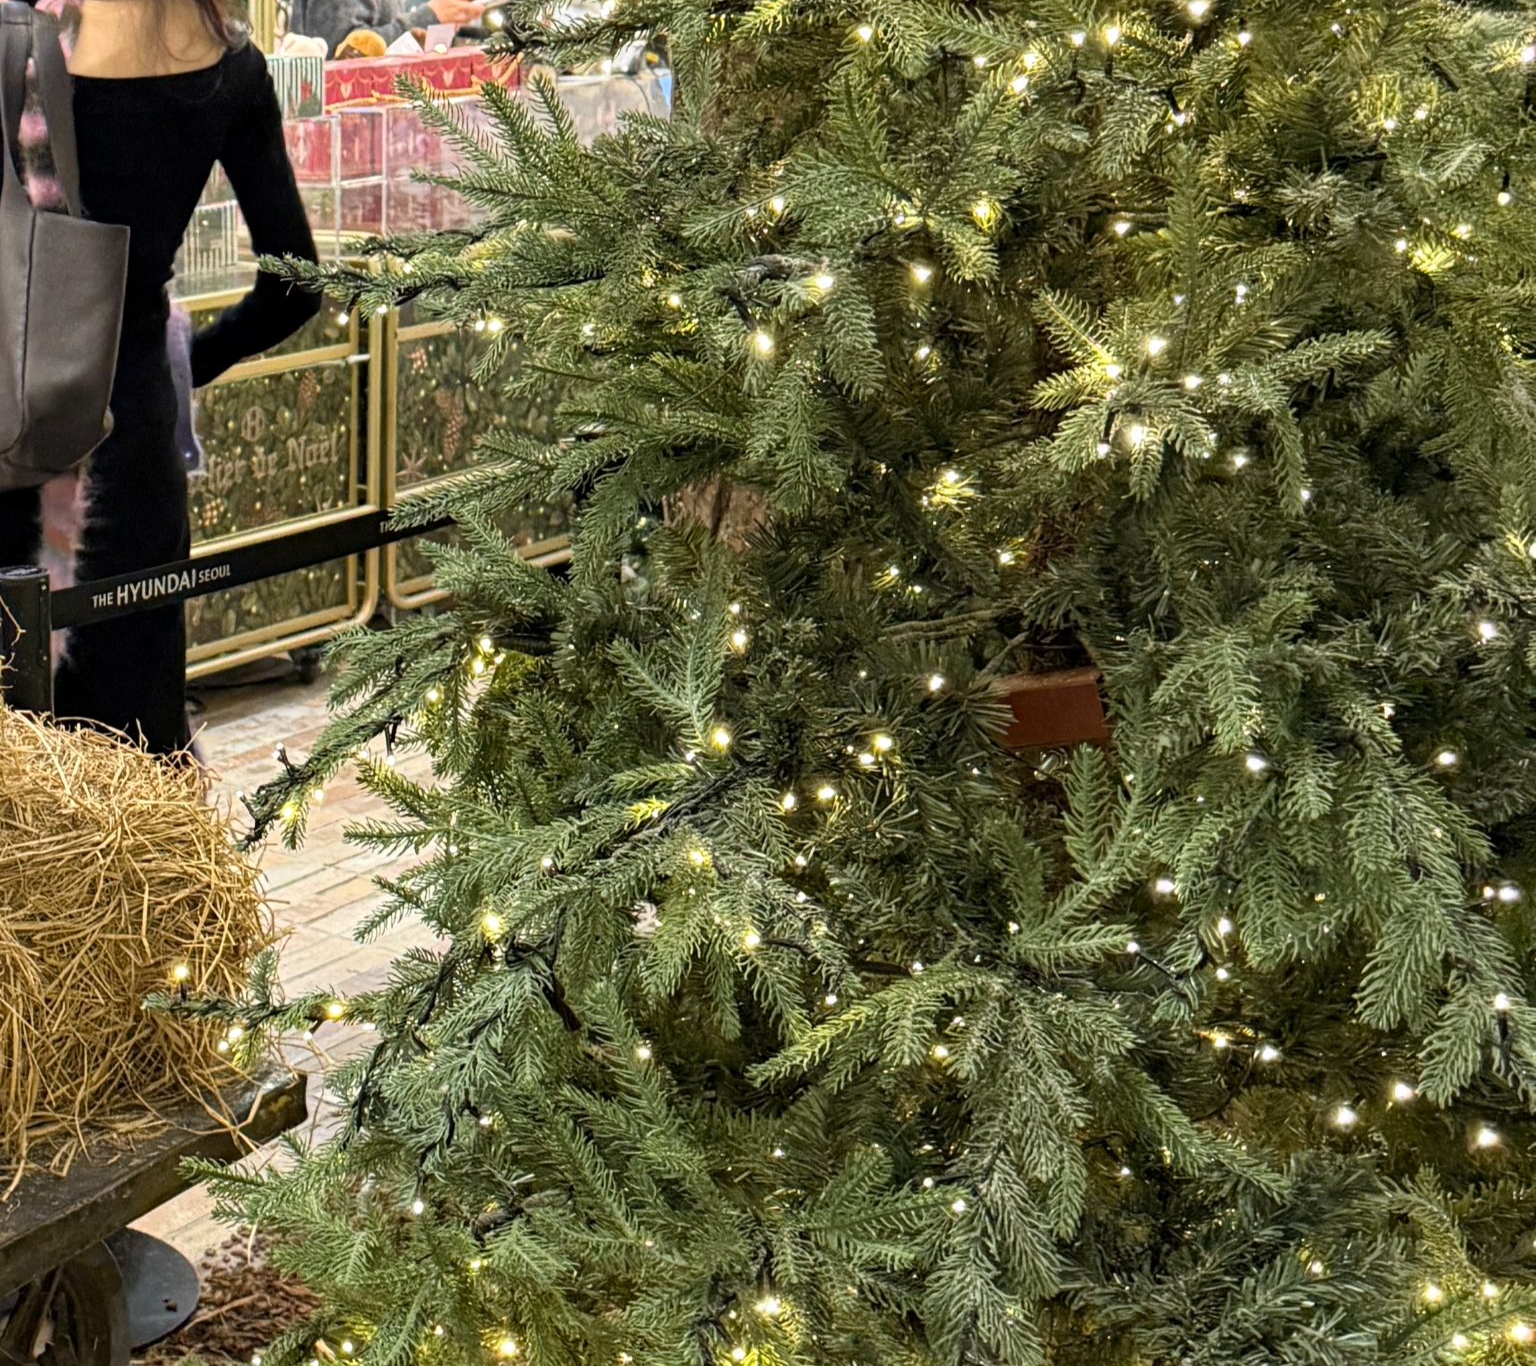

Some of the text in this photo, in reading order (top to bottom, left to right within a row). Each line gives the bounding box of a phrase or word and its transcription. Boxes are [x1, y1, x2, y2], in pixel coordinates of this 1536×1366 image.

[92, 564, 231, 609] THE HYUNDAI SEOUL
